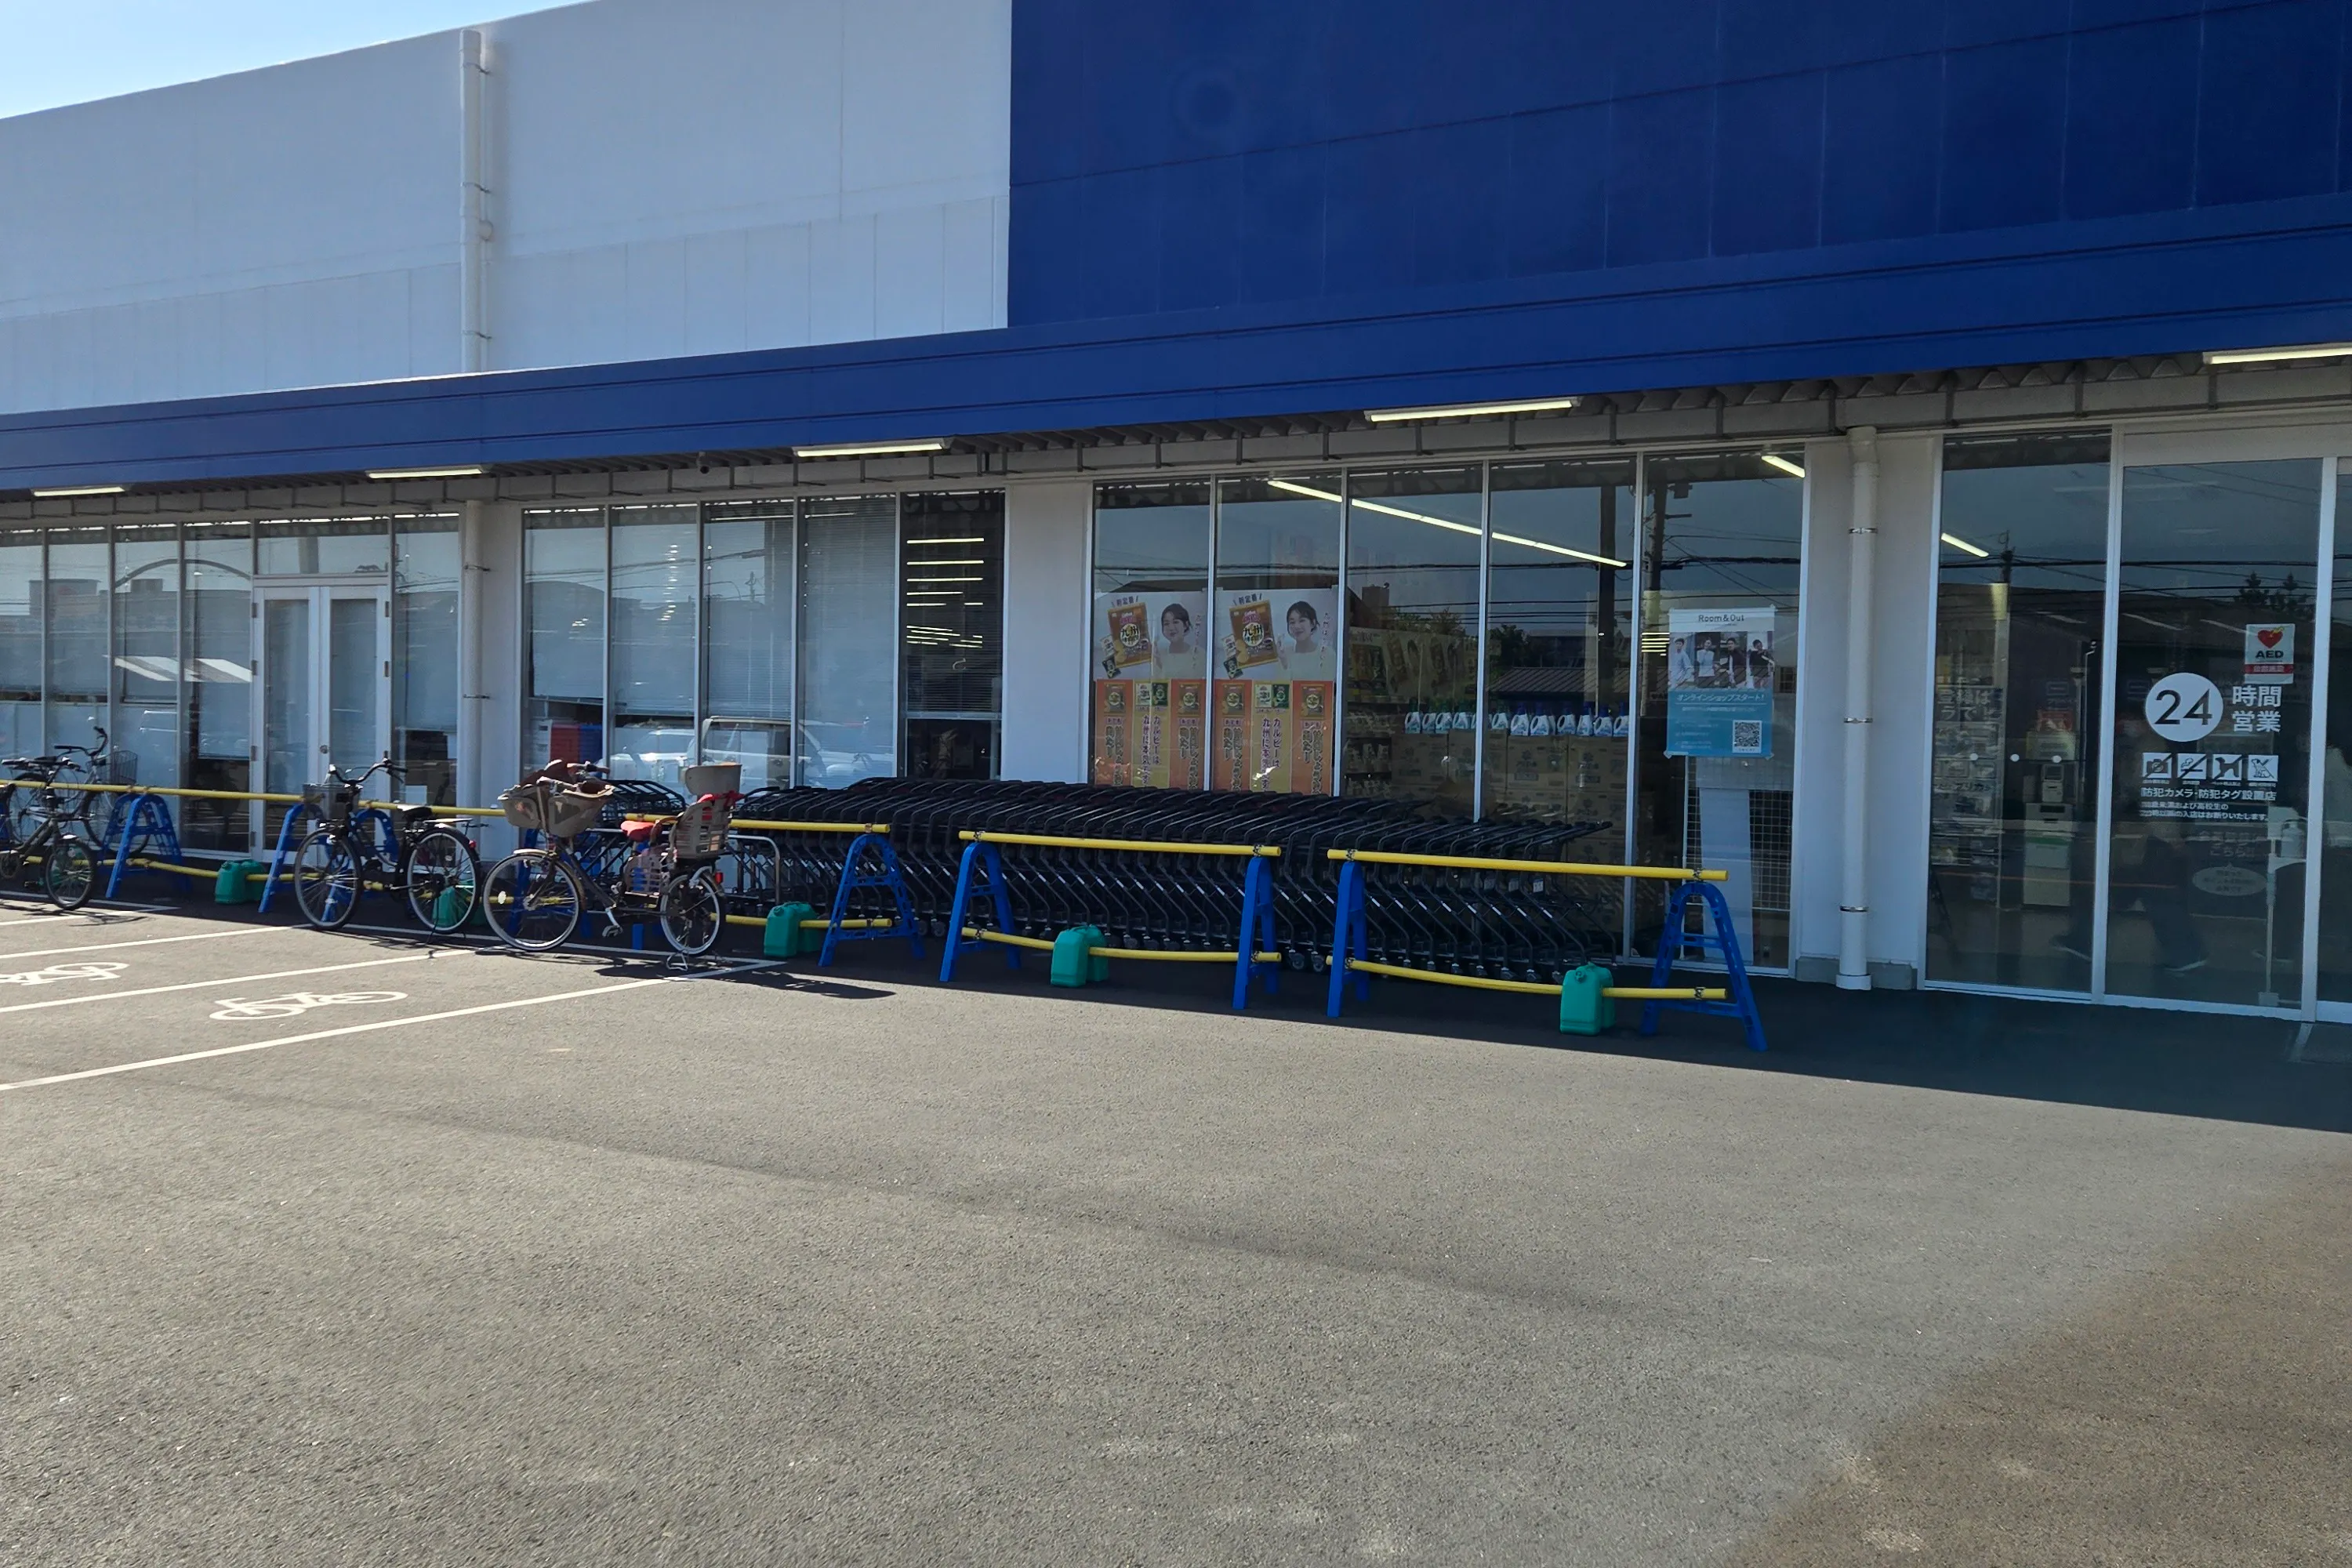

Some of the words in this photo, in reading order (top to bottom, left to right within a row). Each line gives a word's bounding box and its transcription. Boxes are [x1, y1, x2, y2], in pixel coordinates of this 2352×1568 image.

[2255, 650, 2285, 659] AED
[2154, 688, 2213, 726] 24
[2232, 685, 2282, 708] 時間
[2232, 710, 2281, 733] 営業
